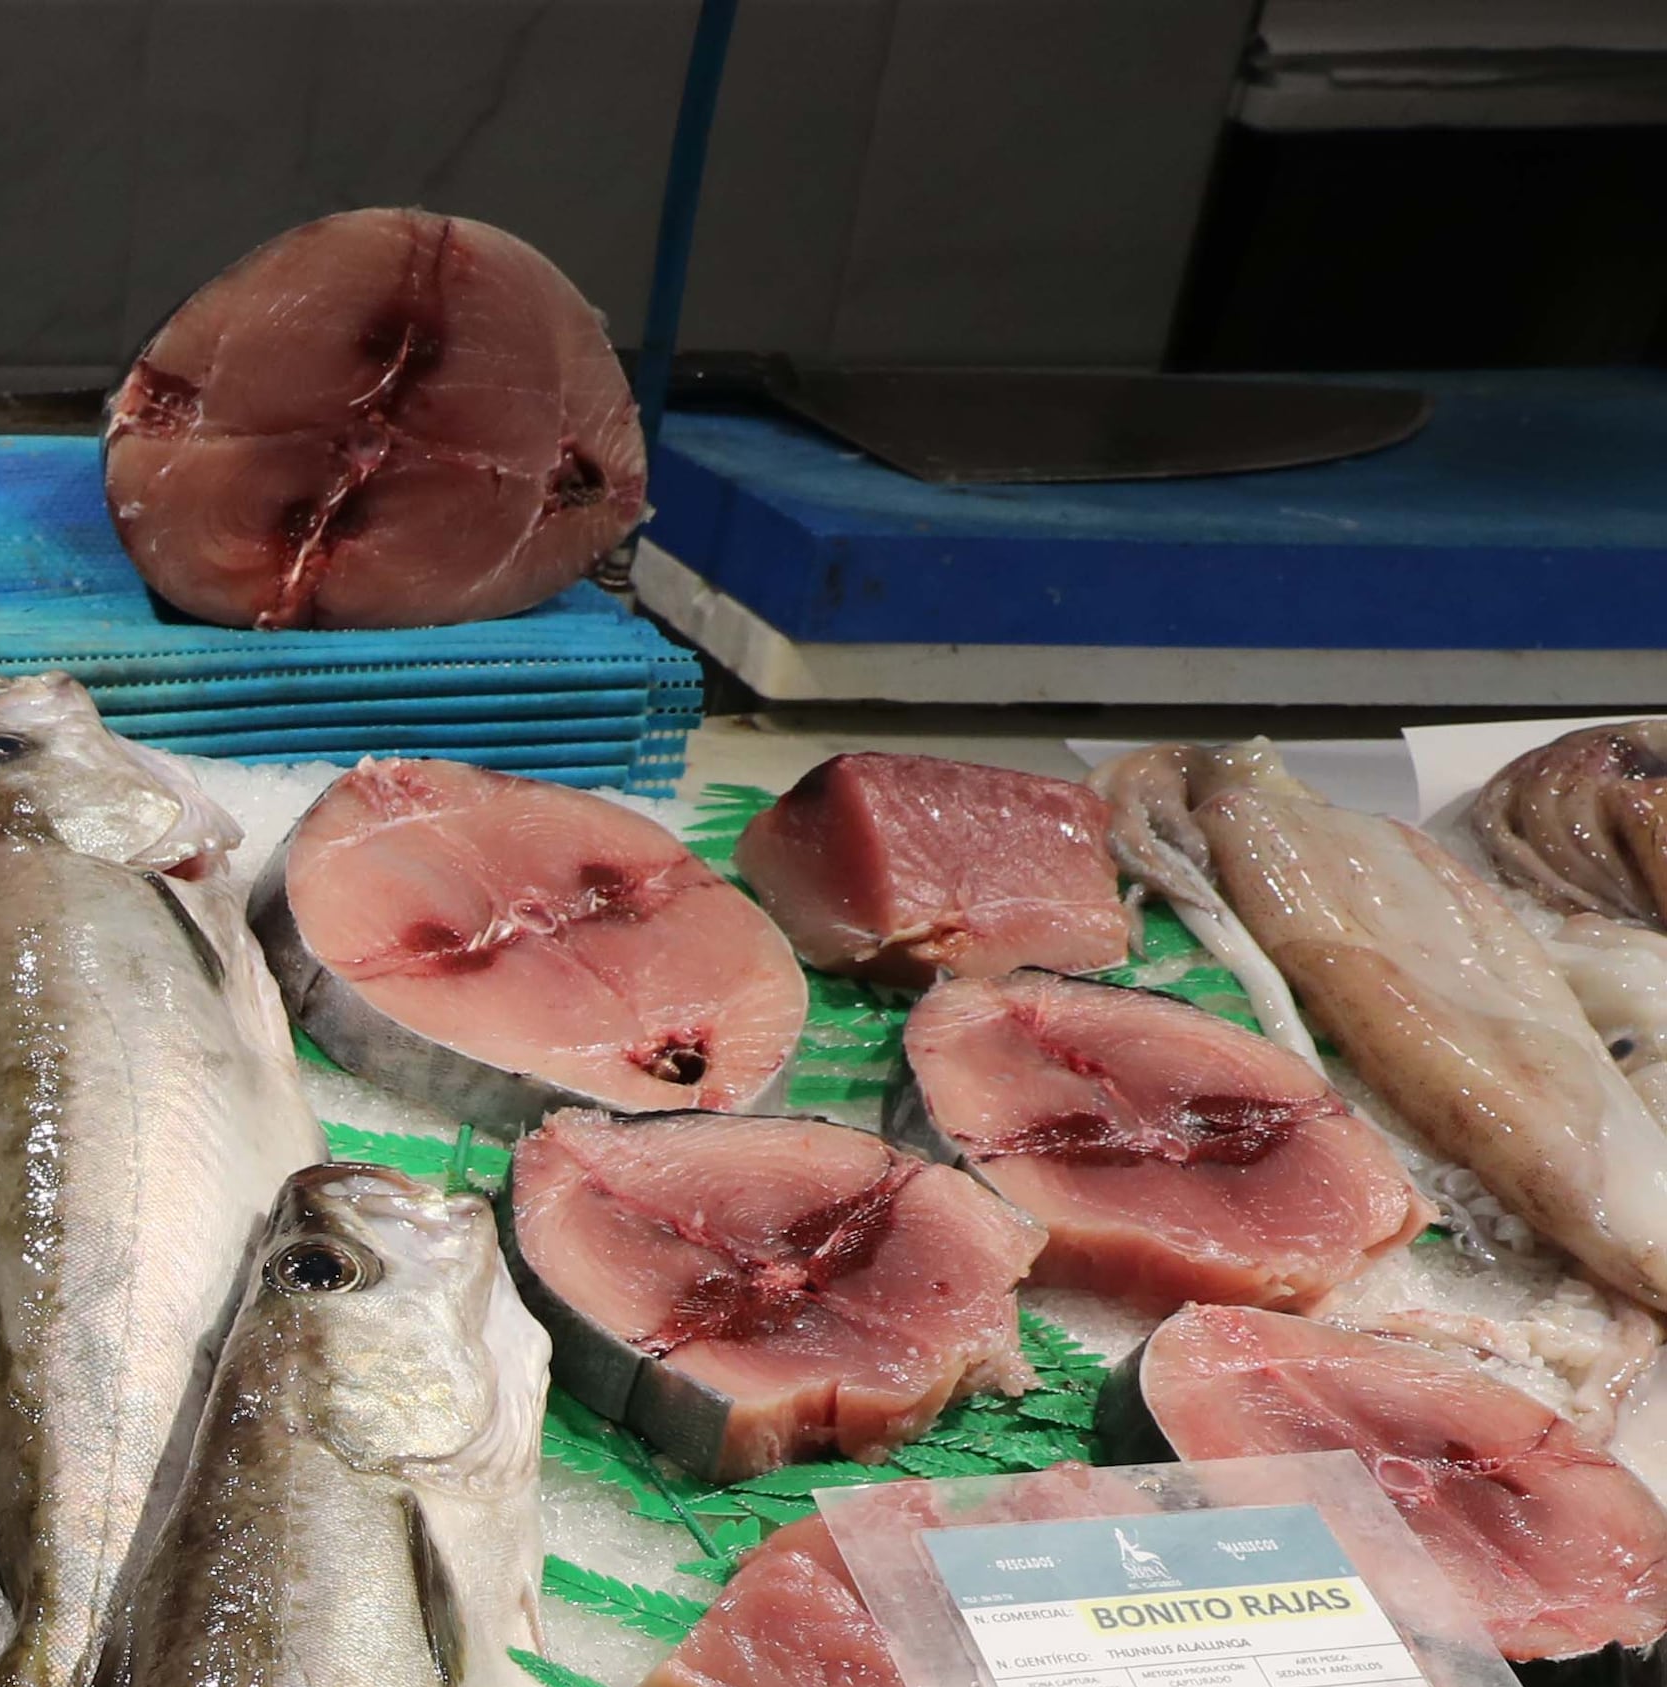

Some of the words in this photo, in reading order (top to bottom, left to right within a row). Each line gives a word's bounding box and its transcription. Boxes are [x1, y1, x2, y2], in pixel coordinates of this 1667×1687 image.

[994, 1555, 1056, 1572] PESCADOS
[1215, 1536, 1284, 1561] MARISCOS
[972, 1613, 990, 1624] N.
[989, 1606, 1076, 1623] COMERCIAL:
[1088, 1595, 1238, 1630] BONITO
[1235, 1586, 1355, 1617] RAJAS
[994, 1657, 1014, 1670] N.
[1011, 1649, 1094, 1668] CIENTÍFICO:
[1104, 1643, 1175, 1659] THUNNUS
[1172, 1636, 1253, 1654] ALALUNGA
[1166, 1674, 1234, 1687] CAPTURADO
[1274, 1667, 1319, 1679] SEDALES
[1317, 1666, 1327, 1674] Y
